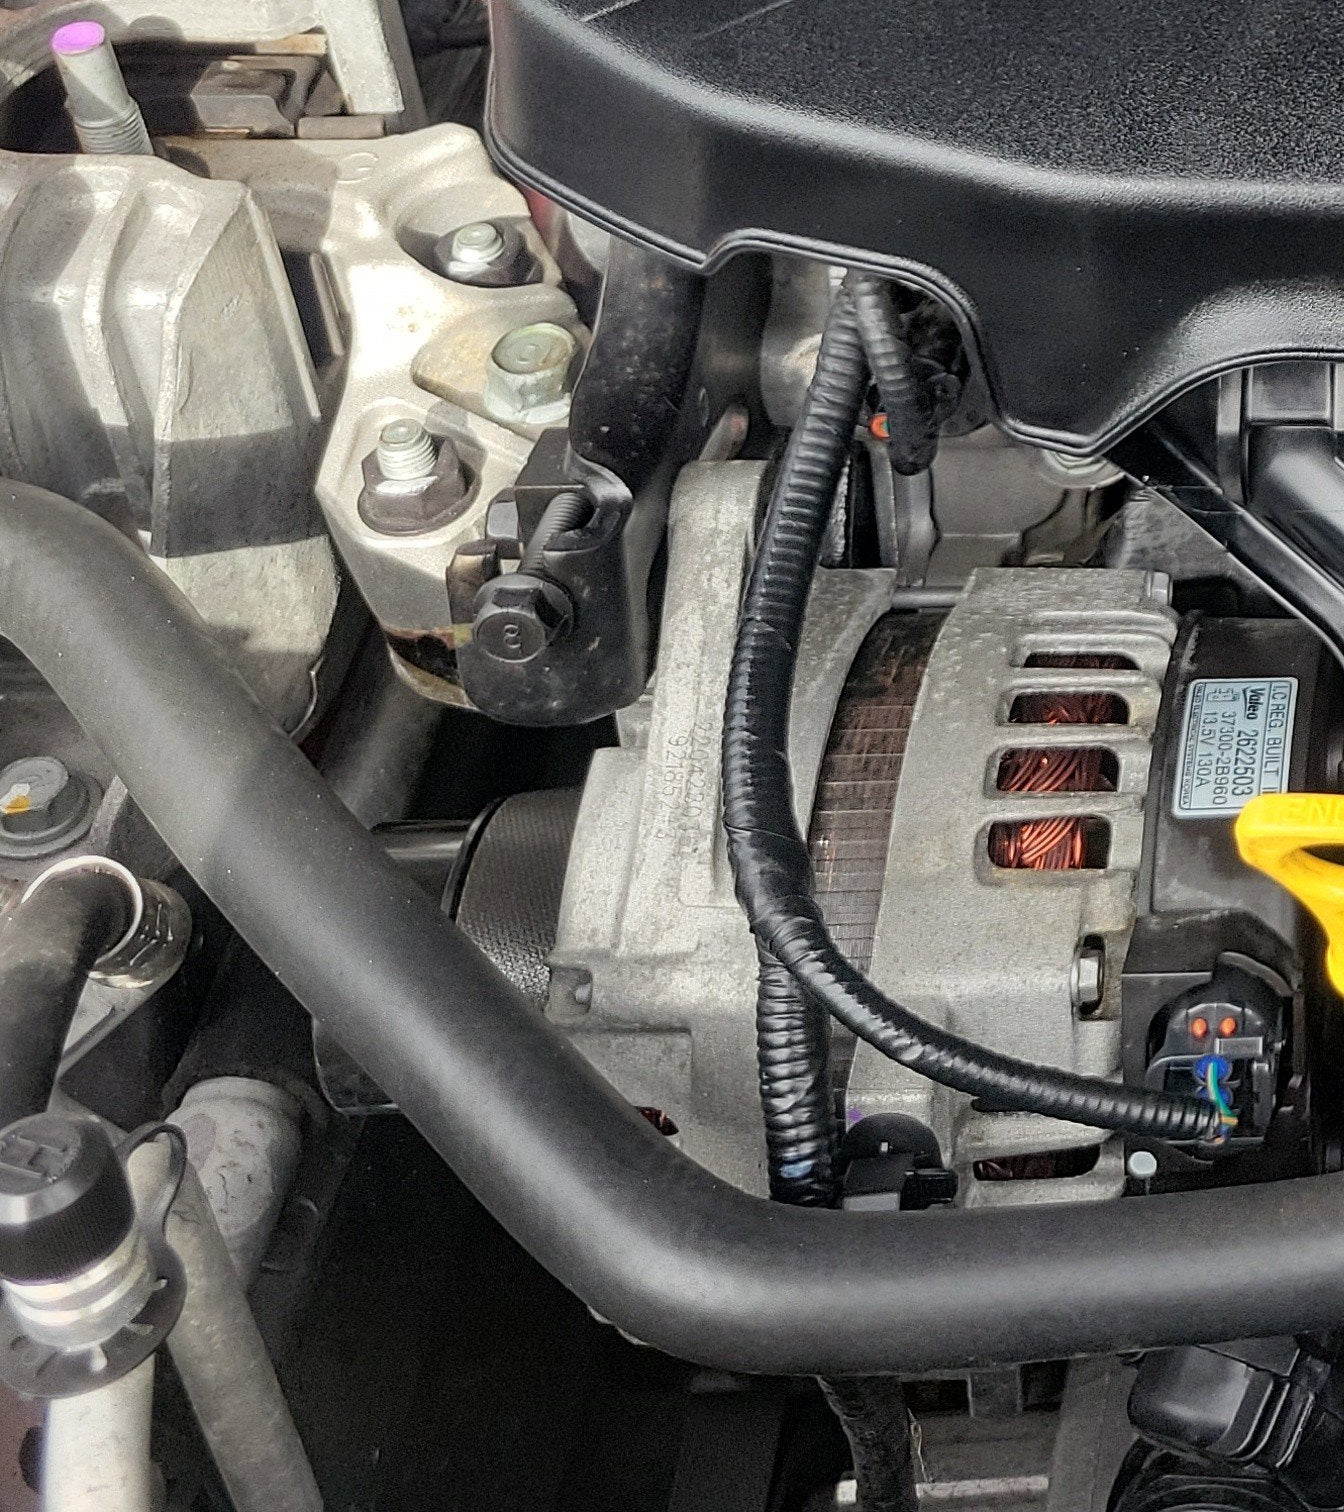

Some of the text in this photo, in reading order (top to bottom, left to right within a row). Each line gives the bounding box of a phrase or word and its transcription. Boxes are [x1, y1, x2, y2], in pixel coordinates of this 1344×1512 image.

[1246, 687, 1266, 720] Valeo
[1267, 703, 1286, 732] REG.
[1194, 711, 1219, 788] 13.5V 130A
[1212, 711, 1237, 806] 37300-2B960
[1231, 729, 1260, 797] 2622503
[1263, 737, 1282, 776] BUILT
